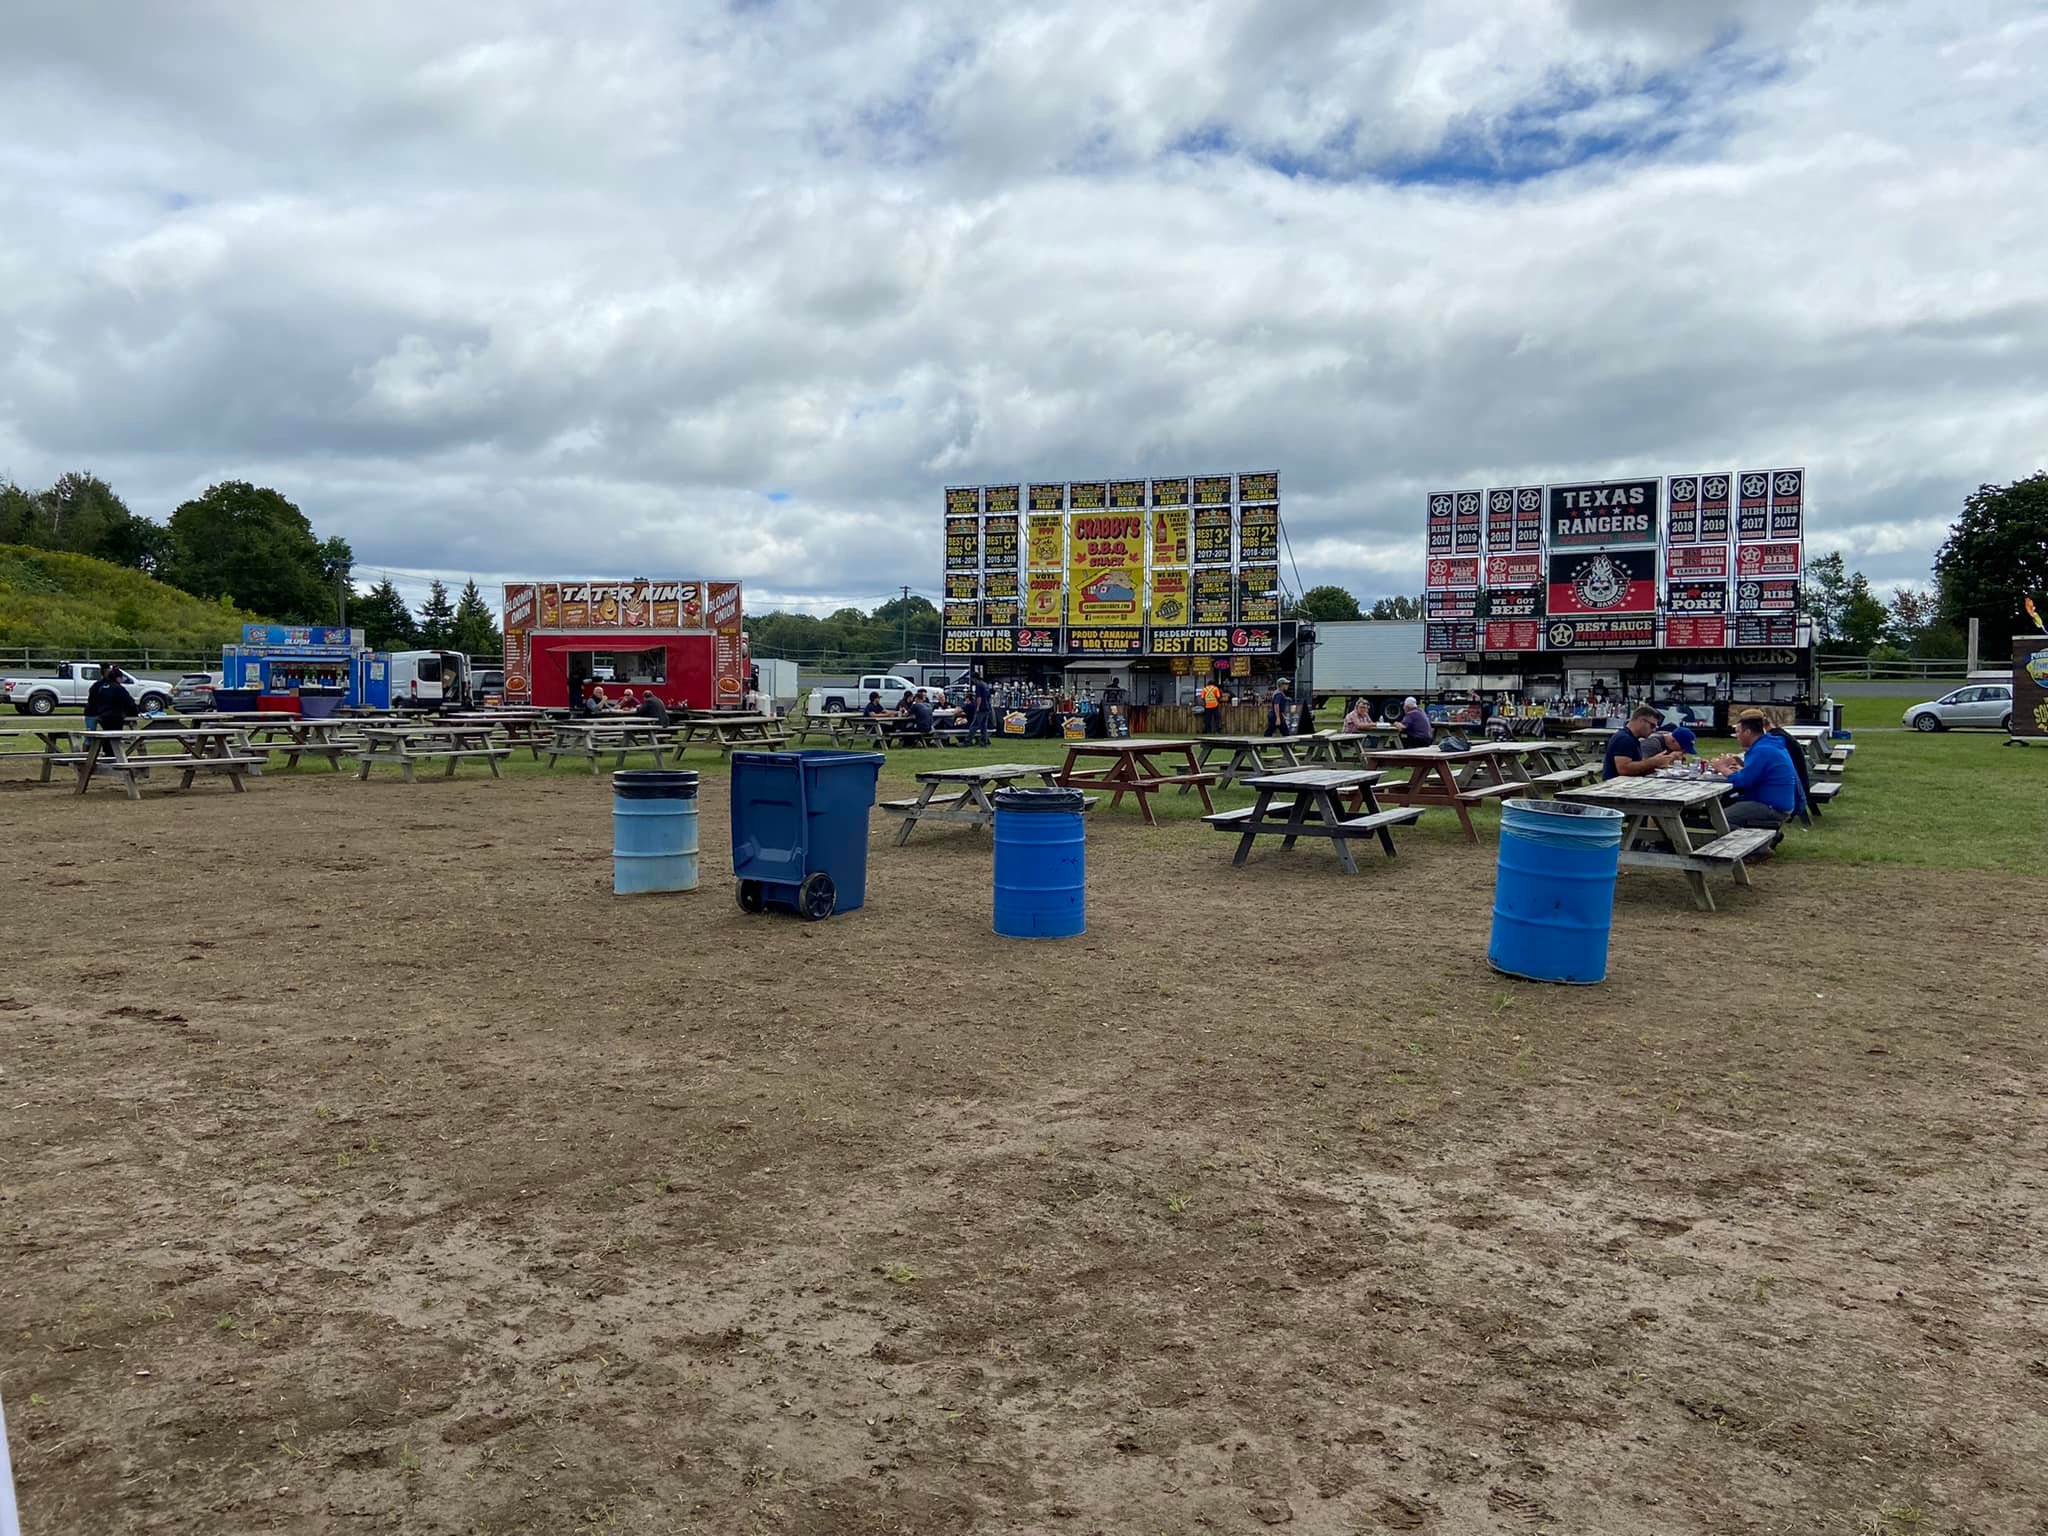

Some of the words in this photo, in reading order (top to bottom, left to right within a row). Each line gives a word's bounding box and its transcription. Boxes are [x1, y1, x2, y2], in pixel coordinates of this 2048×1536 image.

[1563, 488, 1644, 509] TEXAS
[1703, 508, 1726, 516] CHOICE
[1741, 508, 1766, 516] RIBS
[1774, 506, 1798, 514] RIBS
[1671, 511, 1695, 519] RIBS
[1518, 520, 1539, 528] RIBS
[1558, 515, 1649, 535] RANGERS
[1703, 520, 1725, 531] 2019
[1742, 518, 1764, 529] 2017
[1774, 516, 1797, 527] 2017
[1075, 517, 1140, 540] CRABBY'S
[1672, 522, 1694, 532] 2018
[1197, 529, 1213, 539] BEST
[1242, 527, 1259, 537] BEST
[948, 537, 963, 546] BEST
[986, 536, 1003, 545] BEST
[1431, 535, 1450, 545] 2017
[1457, 533, 1478, 543] 2019
[1490, 532, 1510, 542] 2016
[1196, 539, 1213, 549] RIBS
[1242, 538, 1259, 547] RIBS
[948, 547, 963, 556] RIBS
[986, 547, 1004, 555] CHICKEN
[1242, 548, 1276, 557] 2018-2019
[1701, 548, 1724, 556] SAUCE
[1763, 545, 1794, 553] BEST
[1197, 550, 1228, 558] 2017-2019
[1089, 557, 1125, 567] SHACK
[1763, 555, 1794, 563] RIBS
[1509, 565, 1537, 574] CHAMP
[563, 587, 636, 602] TATER
[639, 585, 697, 602] KING
[1577, 588, 1594, 607] TEXAS
[1596, 586, 1627, 607] RANGERS
[1671, 600, 1722, 609] PORK
[1739, 600, 1758, 609] 2019
[512, 602, 531, 624] ONION
[714, 602, 736, 624] ONION
[1490, 606, 1534, 615] BEEF
[1575, 622, 1608, 632] BEST
[1611, 621, 1652, 630] SAUCE
[947, 630, 994, 638] MONCTON
[996, 630, 1011, 638] NB
[1072, 631, 1098, 639] PROUD
[1099, 631, 1139, 639] CANADIAN
[1153, 630, 1212, 638] FREDERICTON
[1575, 630, 1651, 640] FREDERICTON
[945, 638, 978, 652] BEST
[982, 638, 1012, 652] RIBS
[1083, 640, 1100, 648] BBQ
[1103, 640, 1129, 648] TEAM
[1153, 638, 1190, 652] BEST
[1193, 638, 1228, 652] RIBS
[1696, 649, 1797, 665] RANGERS
